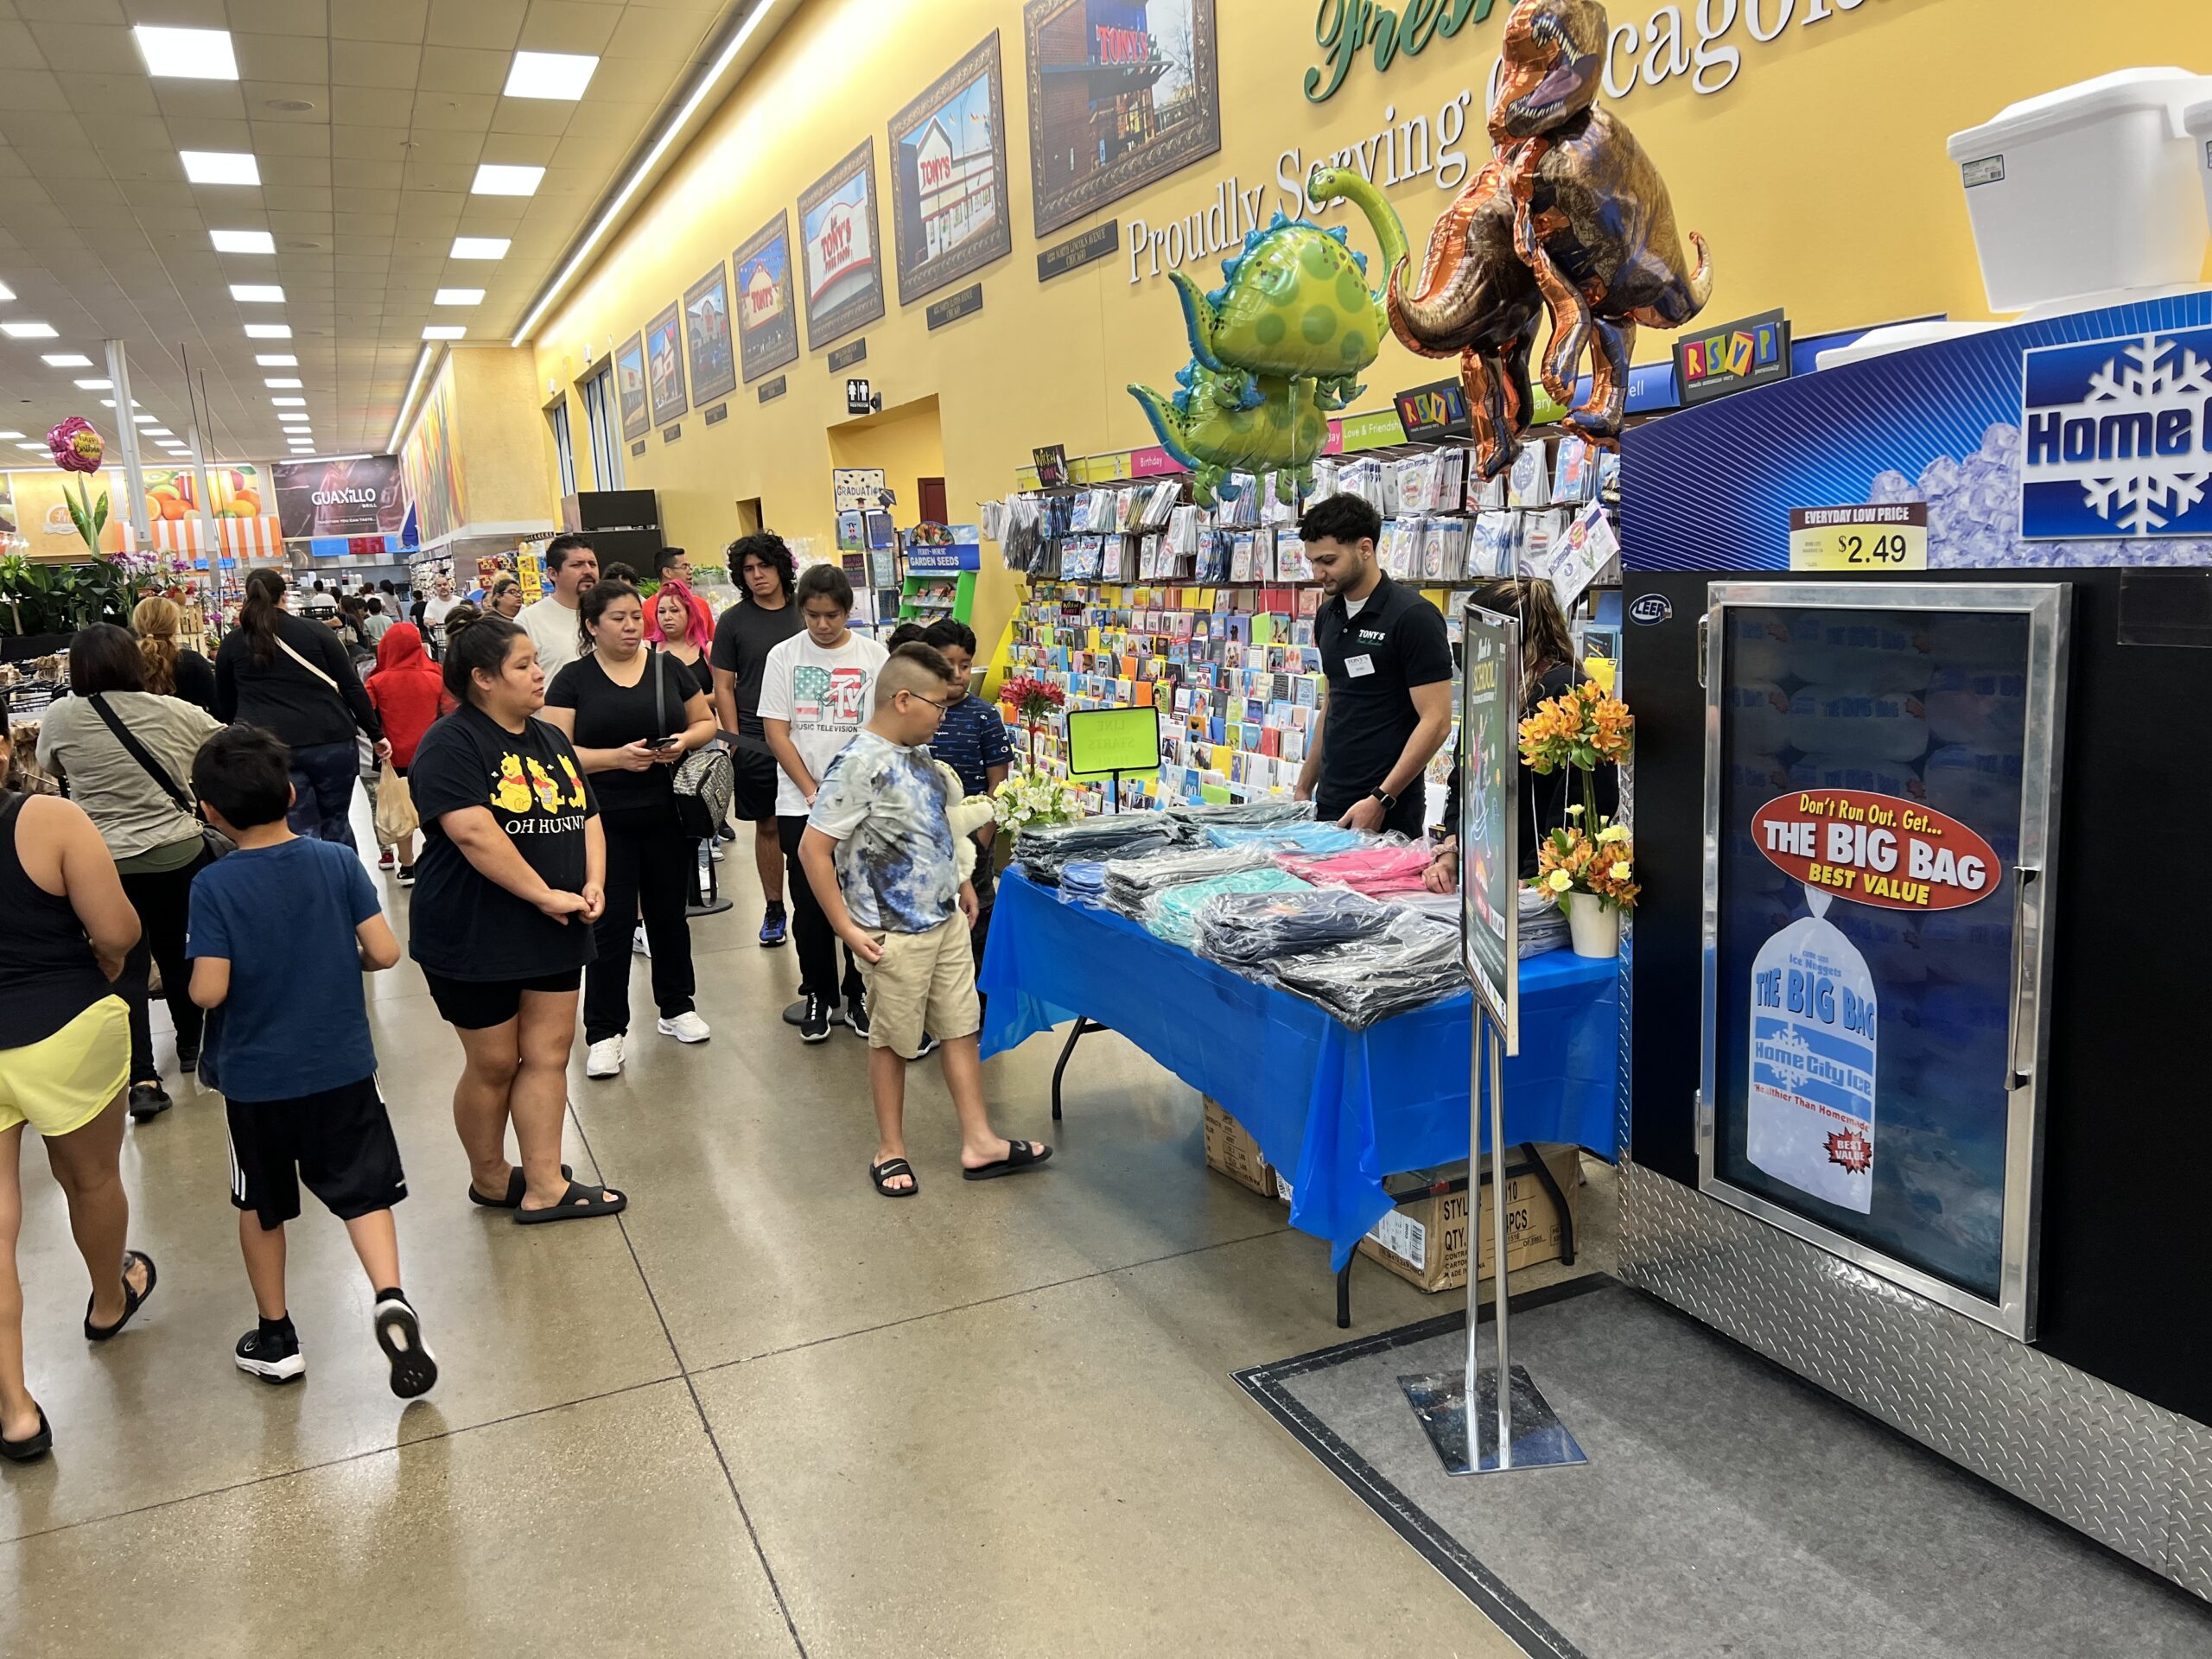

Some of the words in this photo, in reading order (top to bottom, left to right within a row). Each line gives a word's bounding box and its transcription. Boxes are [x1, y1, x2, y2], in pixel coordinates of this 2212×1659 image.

[1096, 23, 1148, 65] TONY'S
[920, 156, 950, 187] TONY'S
[821, 217, 851, 262] TONY'S
[1127, 176, 1264, 283] Proudly
[752, 287, 773, 313] TONY'S
[1688, 330, 1770, 379] RSVP
[1627, 380, 1644, 397] ell
[1405, 392, 1456, 423] RSVP
[1344, 427, 1360, 438] Love
[1362, 425, 1366, 435] &
[1370, 418, 1403, 432] Friendshi
[2027, 409, 2192, 465] Home
[1141, 456, 1163, 467] Birthday
[1805, 509, 1852, 524] EVERYDAY
[1853, 508, 1877, 523] LOW
[1878, 507, 1910, 522] PRICE
[910, 556, 937, 566] GARDEN
[938, 556, 959, 566] SEEDS
[1839, 535, 1906, 563] $2.49
[1636, 601, 1663, 620] LEER
[1359, 629, 1386, 640] TONY'S
[1473, 660, 1495, 692] SCHOOL
[817, 724, 858, 733] TELEVISION
[505, 819, 536, 834] OH
[539, 807, 584, 834] HUNNY
[1800, 794, 1834, 817] Don't
[1839, 799, 1864, 821] Run
[1868, 804, 1897, 827] Out.
[1903, 810, 1942, 835] Get...
[1764, 820, 1815, 857] THE
[1827, 823, 1897, 873] BIG
[1909, 838, 1986, 890] BAG
[1808, 863, 1855, 889] BEST
[1864, 874, 1930, 905] VALUE
[1789, 953, 1802, 966] Ice
[1805, 958, 1841, 977] Nuggets
[1756, 968, 1781, 1008] THE
[1787, 969, 1834, 1024] BIG
[1842, 986, 1874, 1040] BAG
[1755, 1041, 1804, 1070] Home
[1807, 1055, 1845, 1087] City
[1847, 1069, 1872, 1096] Ice
[1795, 1095, 1816, 1111] Than
[1834, 1150, 1865, 1160] VALUE
[1837, 1140, 1863, 1150] BEST
[1444, 1197, 1468, 1221] STYL
[1445, 1227, 1467, 1251] QTY.
